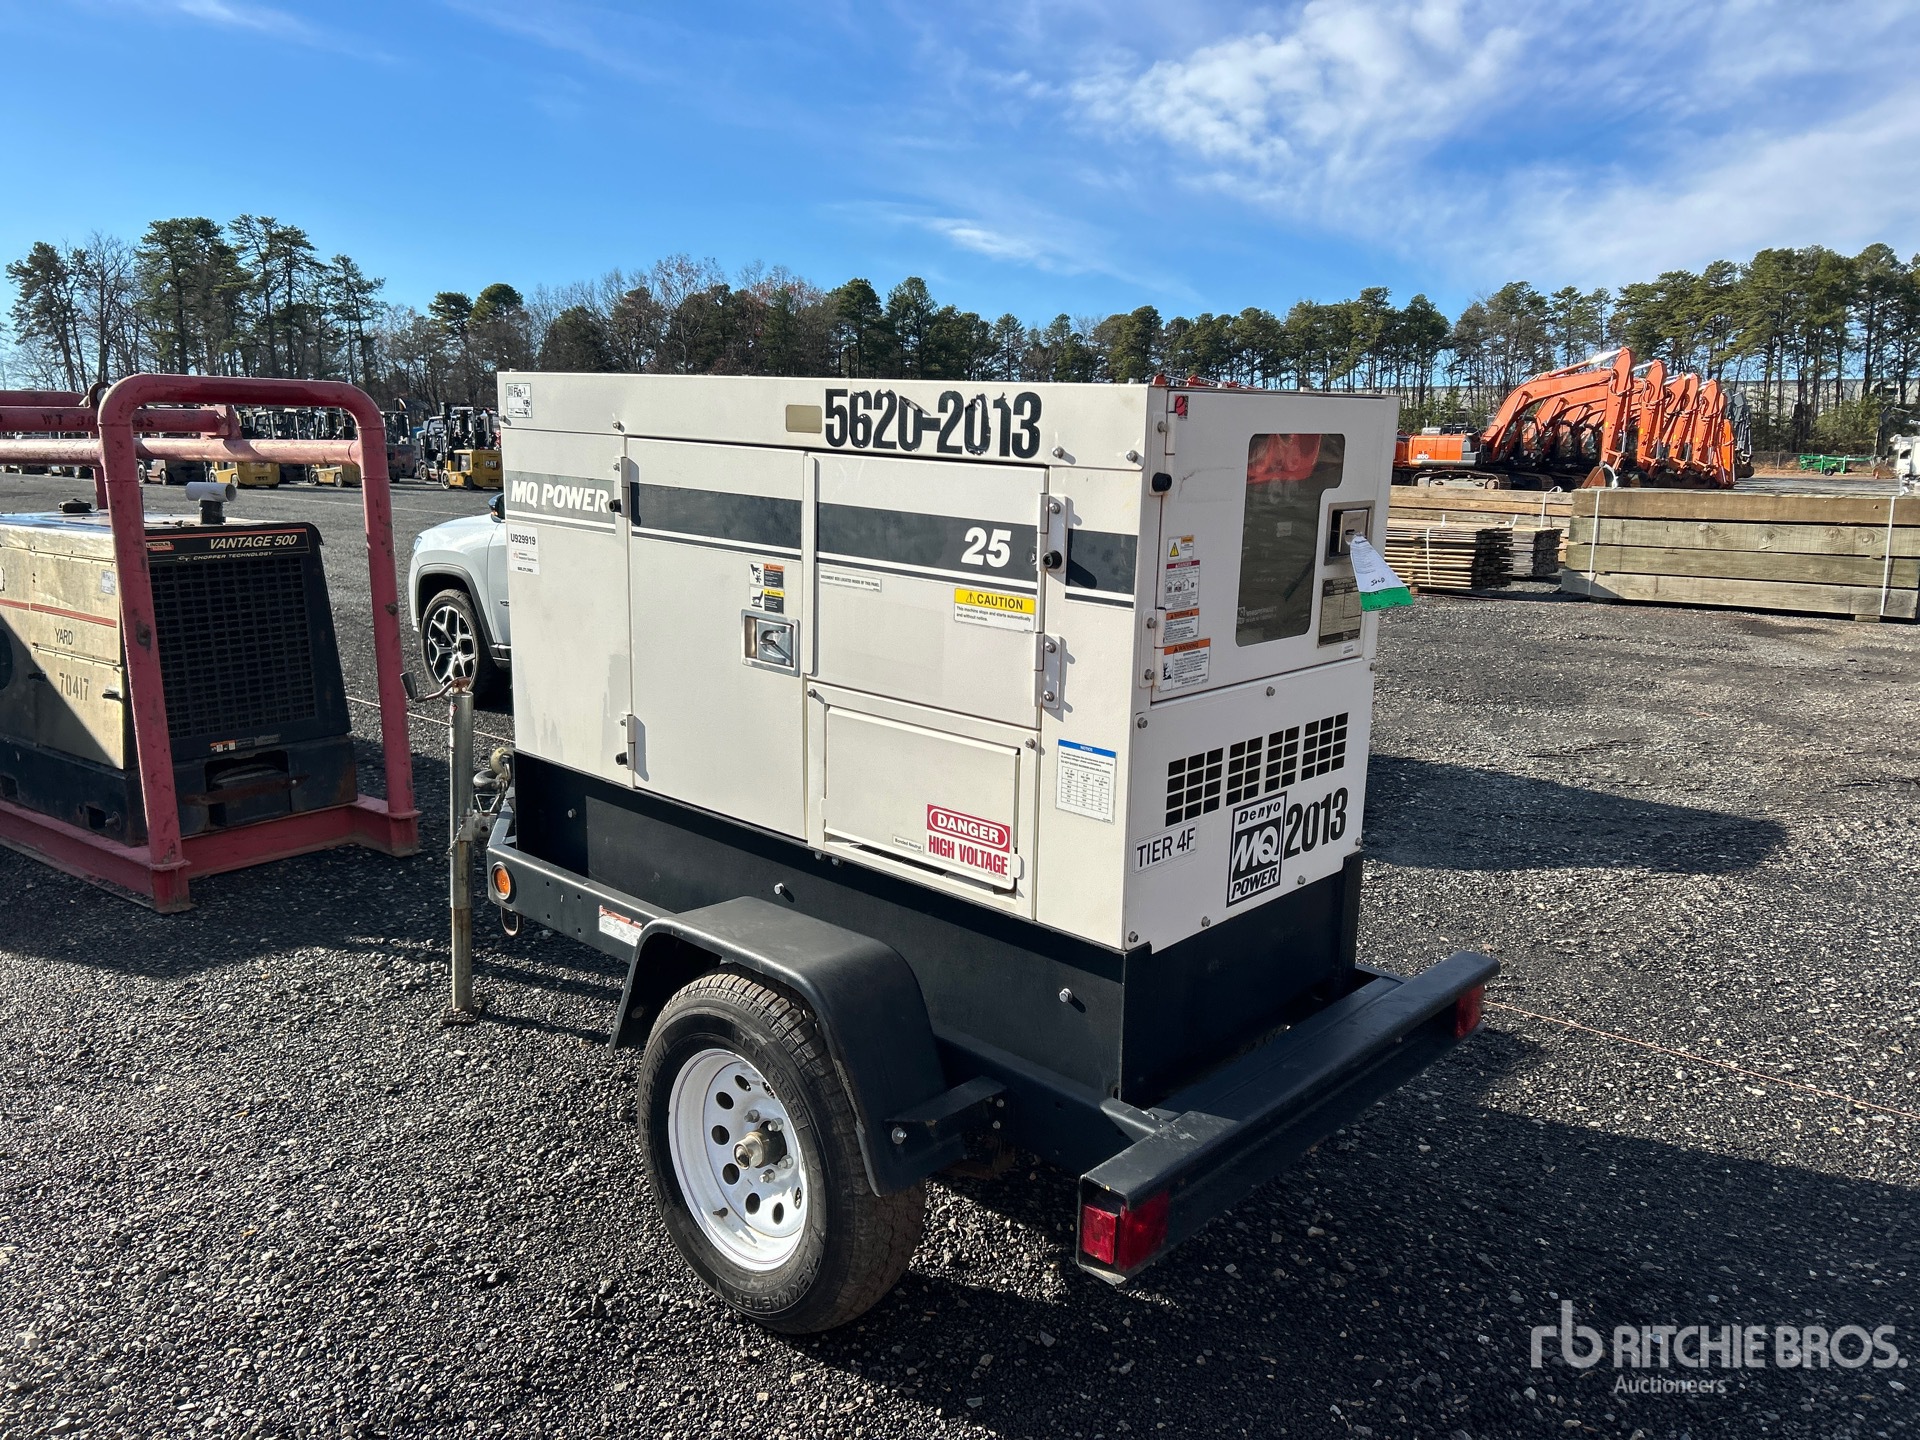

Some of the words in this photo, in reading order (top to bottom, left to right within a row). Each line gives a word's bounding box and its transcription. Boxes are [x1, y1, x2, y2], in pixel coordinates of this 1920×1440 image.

[825, 388, 1042, 459] 5620-2013
[485, 460, 497, 469] CAT
[511, 480, 538, 508] MQ
[541, 483, 609, 513] POWER
[210, 536, 272, 550] VANTAGE
[274, 535, 298, 546] 500
[510, 533, 536, 545] U929919
[960, 527, 1012, 568] 25
[193, 553, 226, 561] CHOPPER
[228, 550, 273, 559] TECHNOLOGY
[976, 594, 1023, 610] CAUTION
[1007, 614, 1031, 622] automatically
[54, 628, 73, 645] YARD
[59, 672, 89, 701] 70417
[1238, 801, 1281, 825] Denyo
[1283, 787, 1349, 861] 2013
[937, 813, 999, 844] DANGER
[928, 835, 955, 859] HIGH
[958, 843, 1008, 876] VOLTAGE
[1136, 836, 1173, 867] TIER
[1176, 827, 1196, 852] 4F
[1233, 825, 1279, 874] MQ
[1231, 867, 1278, 899] POWER
